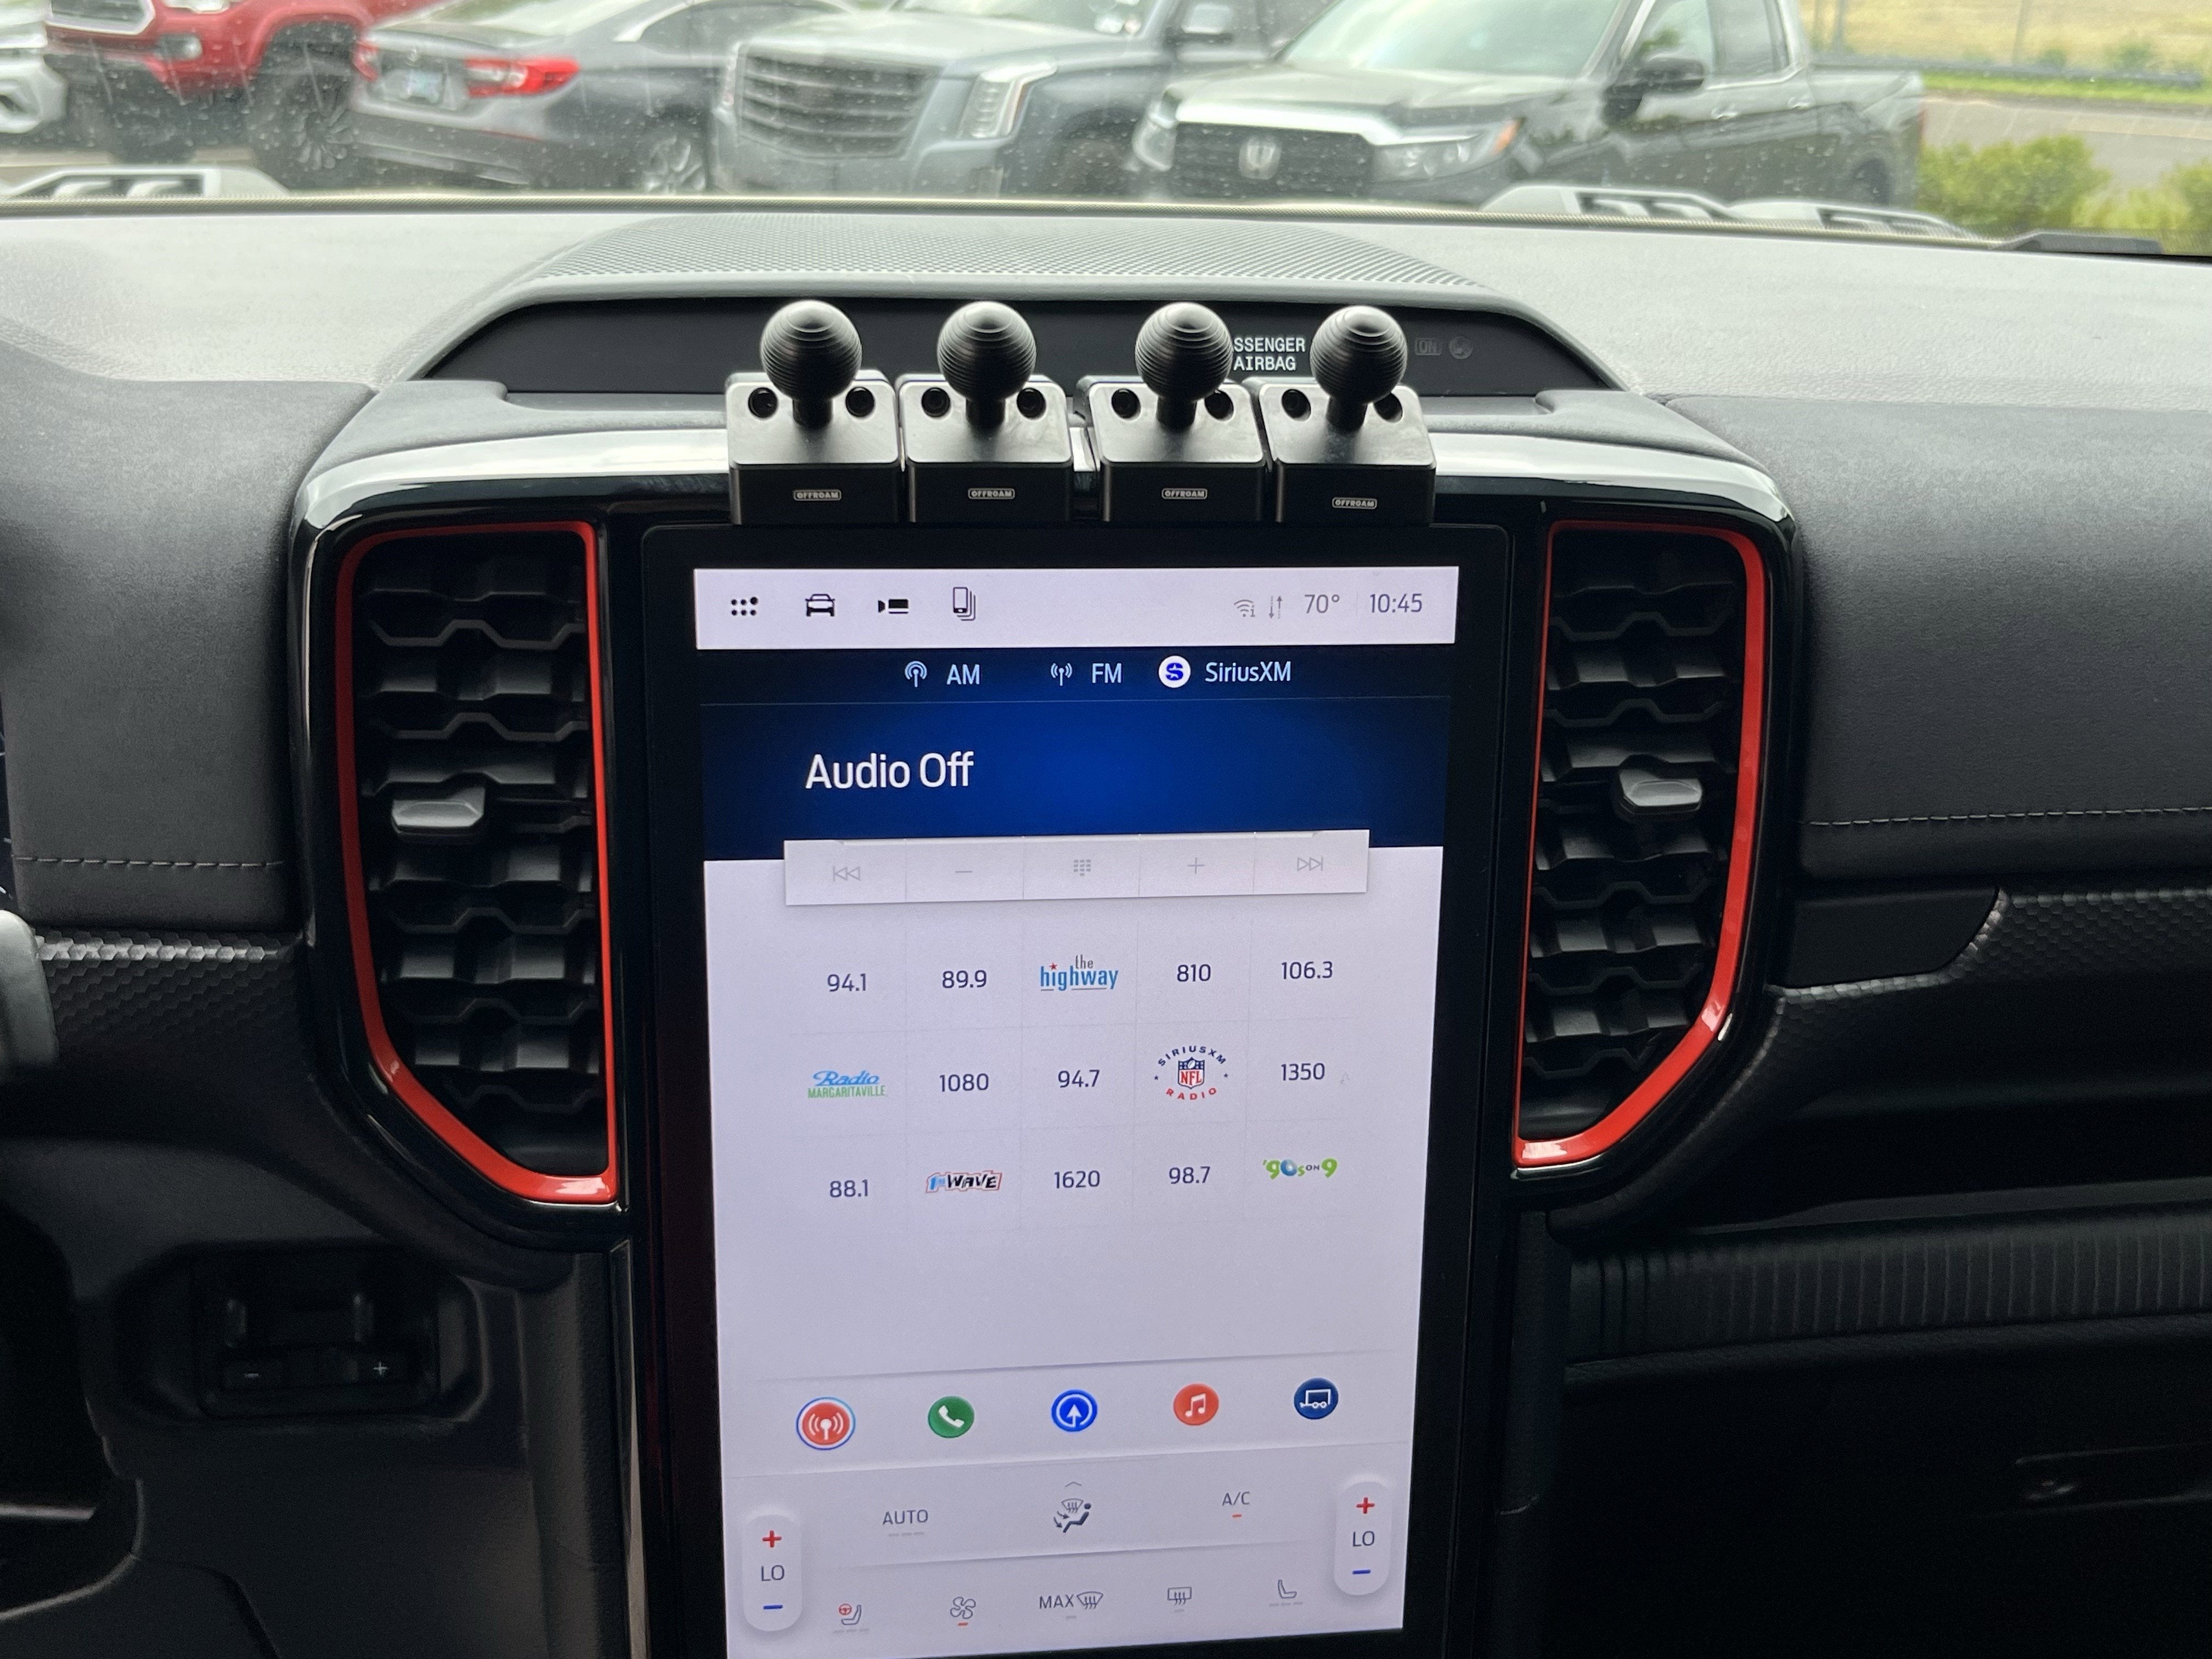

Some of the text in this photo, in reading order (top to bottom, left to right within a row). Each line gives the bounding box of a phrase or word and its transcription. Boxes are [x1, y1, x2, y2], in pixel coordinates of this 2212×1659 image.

[1234, 337, 1306, 353] SSENGER
[1233, 356, 1297, 371] AIRBAG
[1305, 594, 1340, 614] 70°
[1370, 593, 1423, 613] 10:45
[946, 664, 980, 685] AM
[1092, 663, 1122, 684] FM
[1205, 661, 1291, 682] SiriusXM
[805, 751, 974, 789] Audio Off
[1075, 954, 1093, 969] the
[1281, 961, 1333, 980] 106.3
[942, 969, 988, 989] 89.9
[1041, 966, 1119, 991] highway
[1177, 964, 1211, 982] 810
[827, 973, 867, 992] 94.1
[1058, 1069, 1101, 1088] 94.7
[1181, 1070, 1202, 1085] NFL
[1280, 1063, 1325, 1081] 1350
[808, 1085, 885, 1098] MARGARITAVILLE
[939, 1073, 989, 1092] 1080
[1166, 1088, 1216, 1100] RADIO
[1054, 1170, 1101, 1189] 1620
[1169, 1166, 1211, 1184] 98.7
[830, 1179, 869, 1198] 88.1
[1222, 1491, 1250, 1506] A/C
[882, 1509, 929, 1525] AUTO
[1352, 1531, 1375, 1547] LO
[761, 1565, 785, 1582] LO
[1040, 1594, 1074, 1609] MAX
